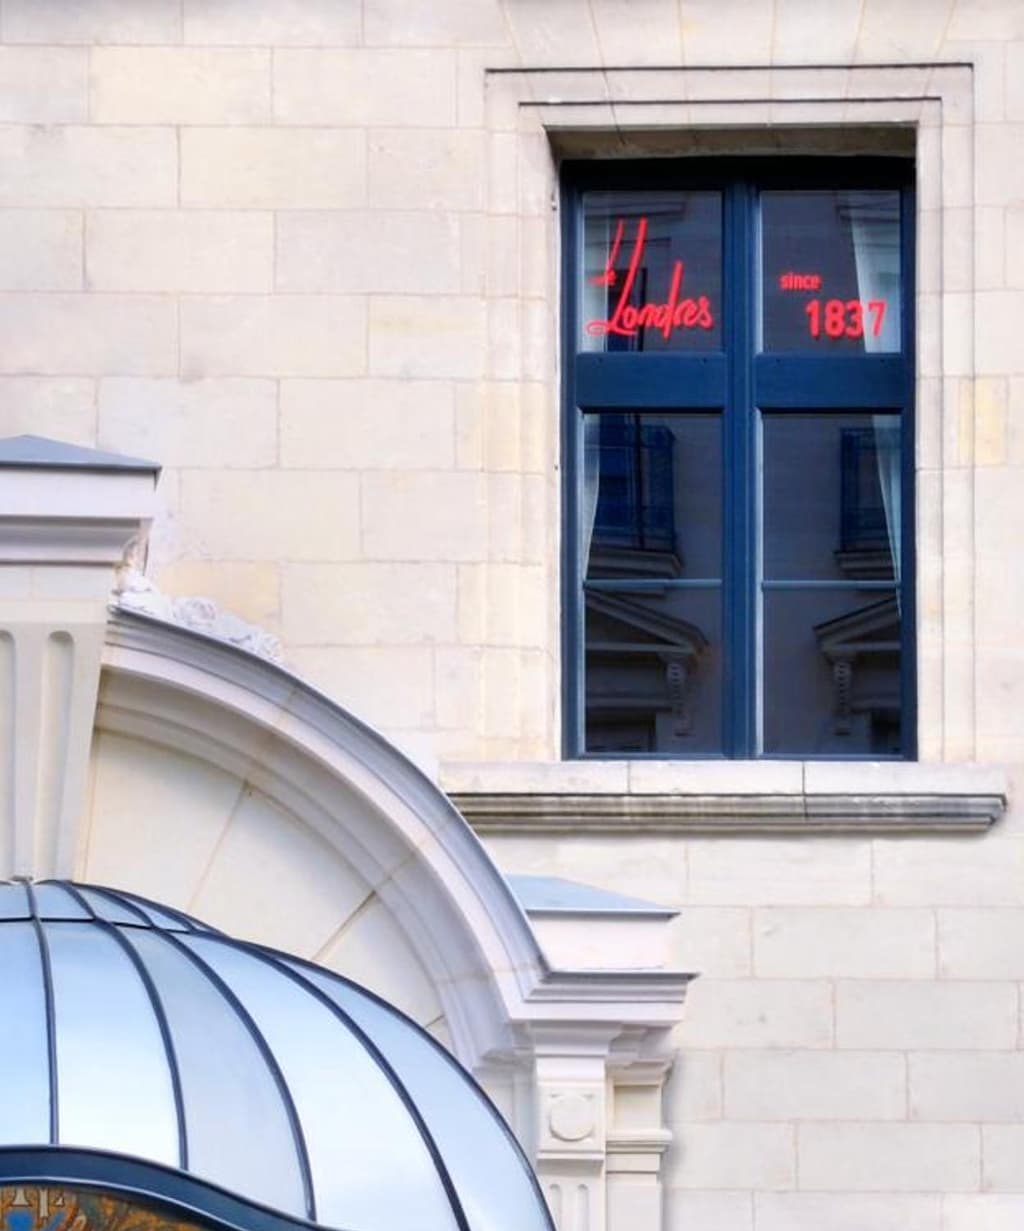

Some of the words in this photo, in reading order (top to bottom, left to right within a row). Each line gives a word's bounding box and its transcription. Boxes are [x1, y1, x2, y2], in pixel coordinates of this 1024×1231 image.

[585, 216, 714, 341] Londres
[780, 271, 821, 290] since
[805, 300, 886, 339] 1837
